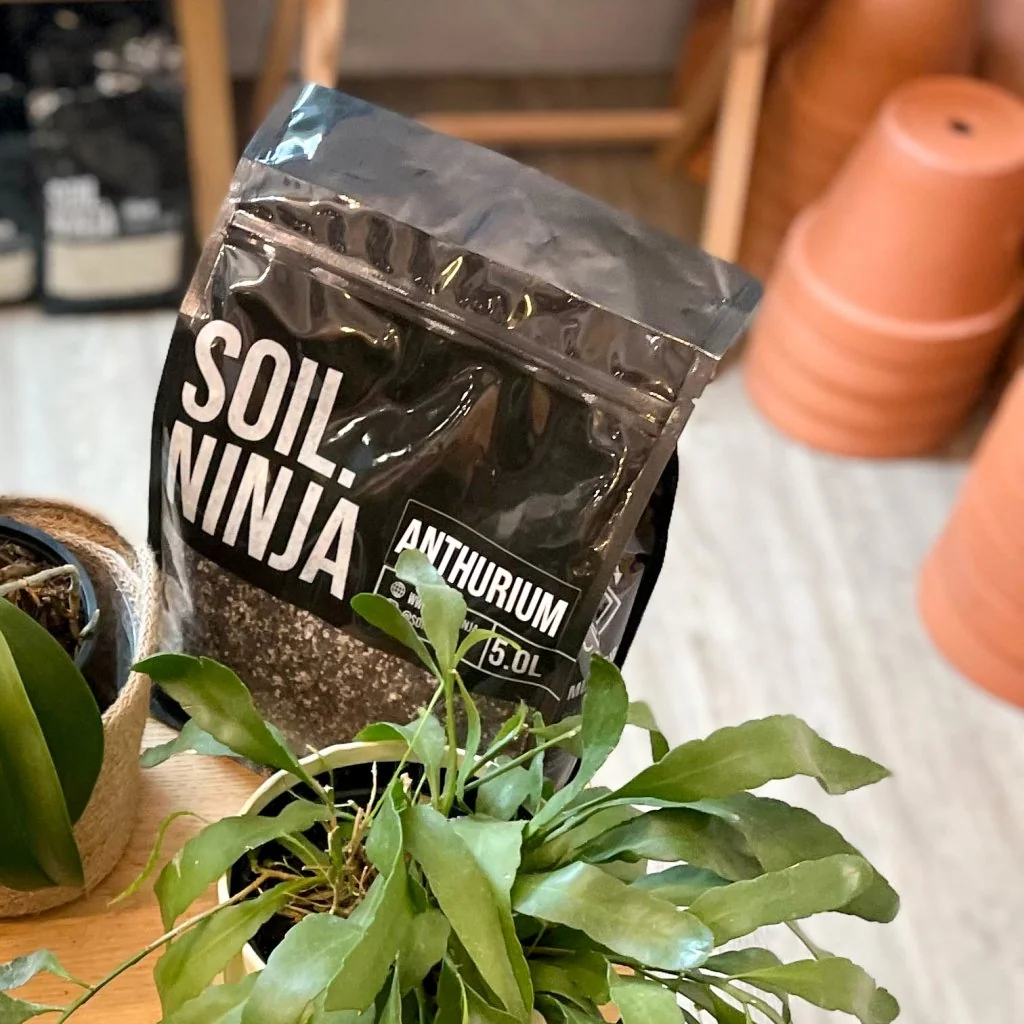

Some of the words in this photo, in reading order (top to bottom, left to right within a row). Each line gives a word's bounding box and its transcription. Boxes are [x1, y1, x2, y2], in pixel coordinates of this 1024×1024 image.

[168, 419, 360, 601] NINJA
[394, 518, 569, 638] ANTHURIUM
[488, 637, 542, 678] 5.0L
